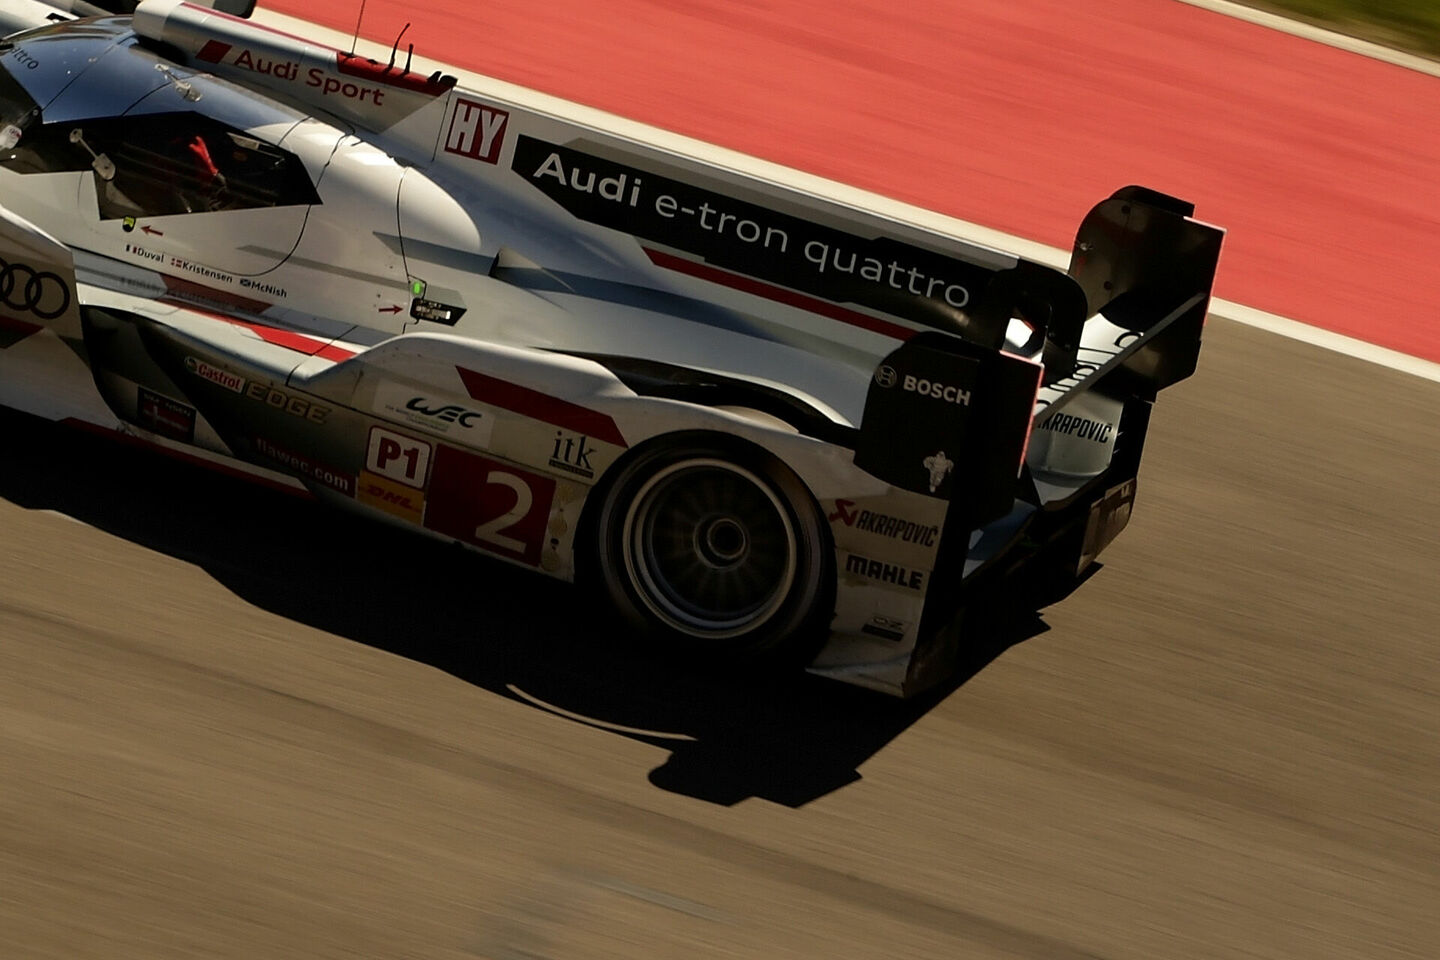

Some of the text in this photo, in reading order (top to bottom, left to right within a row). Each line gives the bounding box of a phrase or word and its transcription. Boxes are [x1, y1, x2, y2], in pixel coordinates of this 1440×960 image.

[234, 49, 385, 106] Audi Sport
[447, 103, 507, 158] HY
[533, 152, 970, 309] Audi e-tron quattro
[137, 247, 288, 298] Duval Kristensen McNish
[198, 361, 332, 425] Castrol EDGE
[406, 397, 482, 428] WEC
[903, 374, 972, 406] BOSCH
[552, 431, 597, 470] itk
[1038, 412, 1113, 443] KRAPOVIČ
[377, 437, 420, 480] P1
[474, 470, 533, 555] 2
[845, 554, 923, 590] MAHLE
